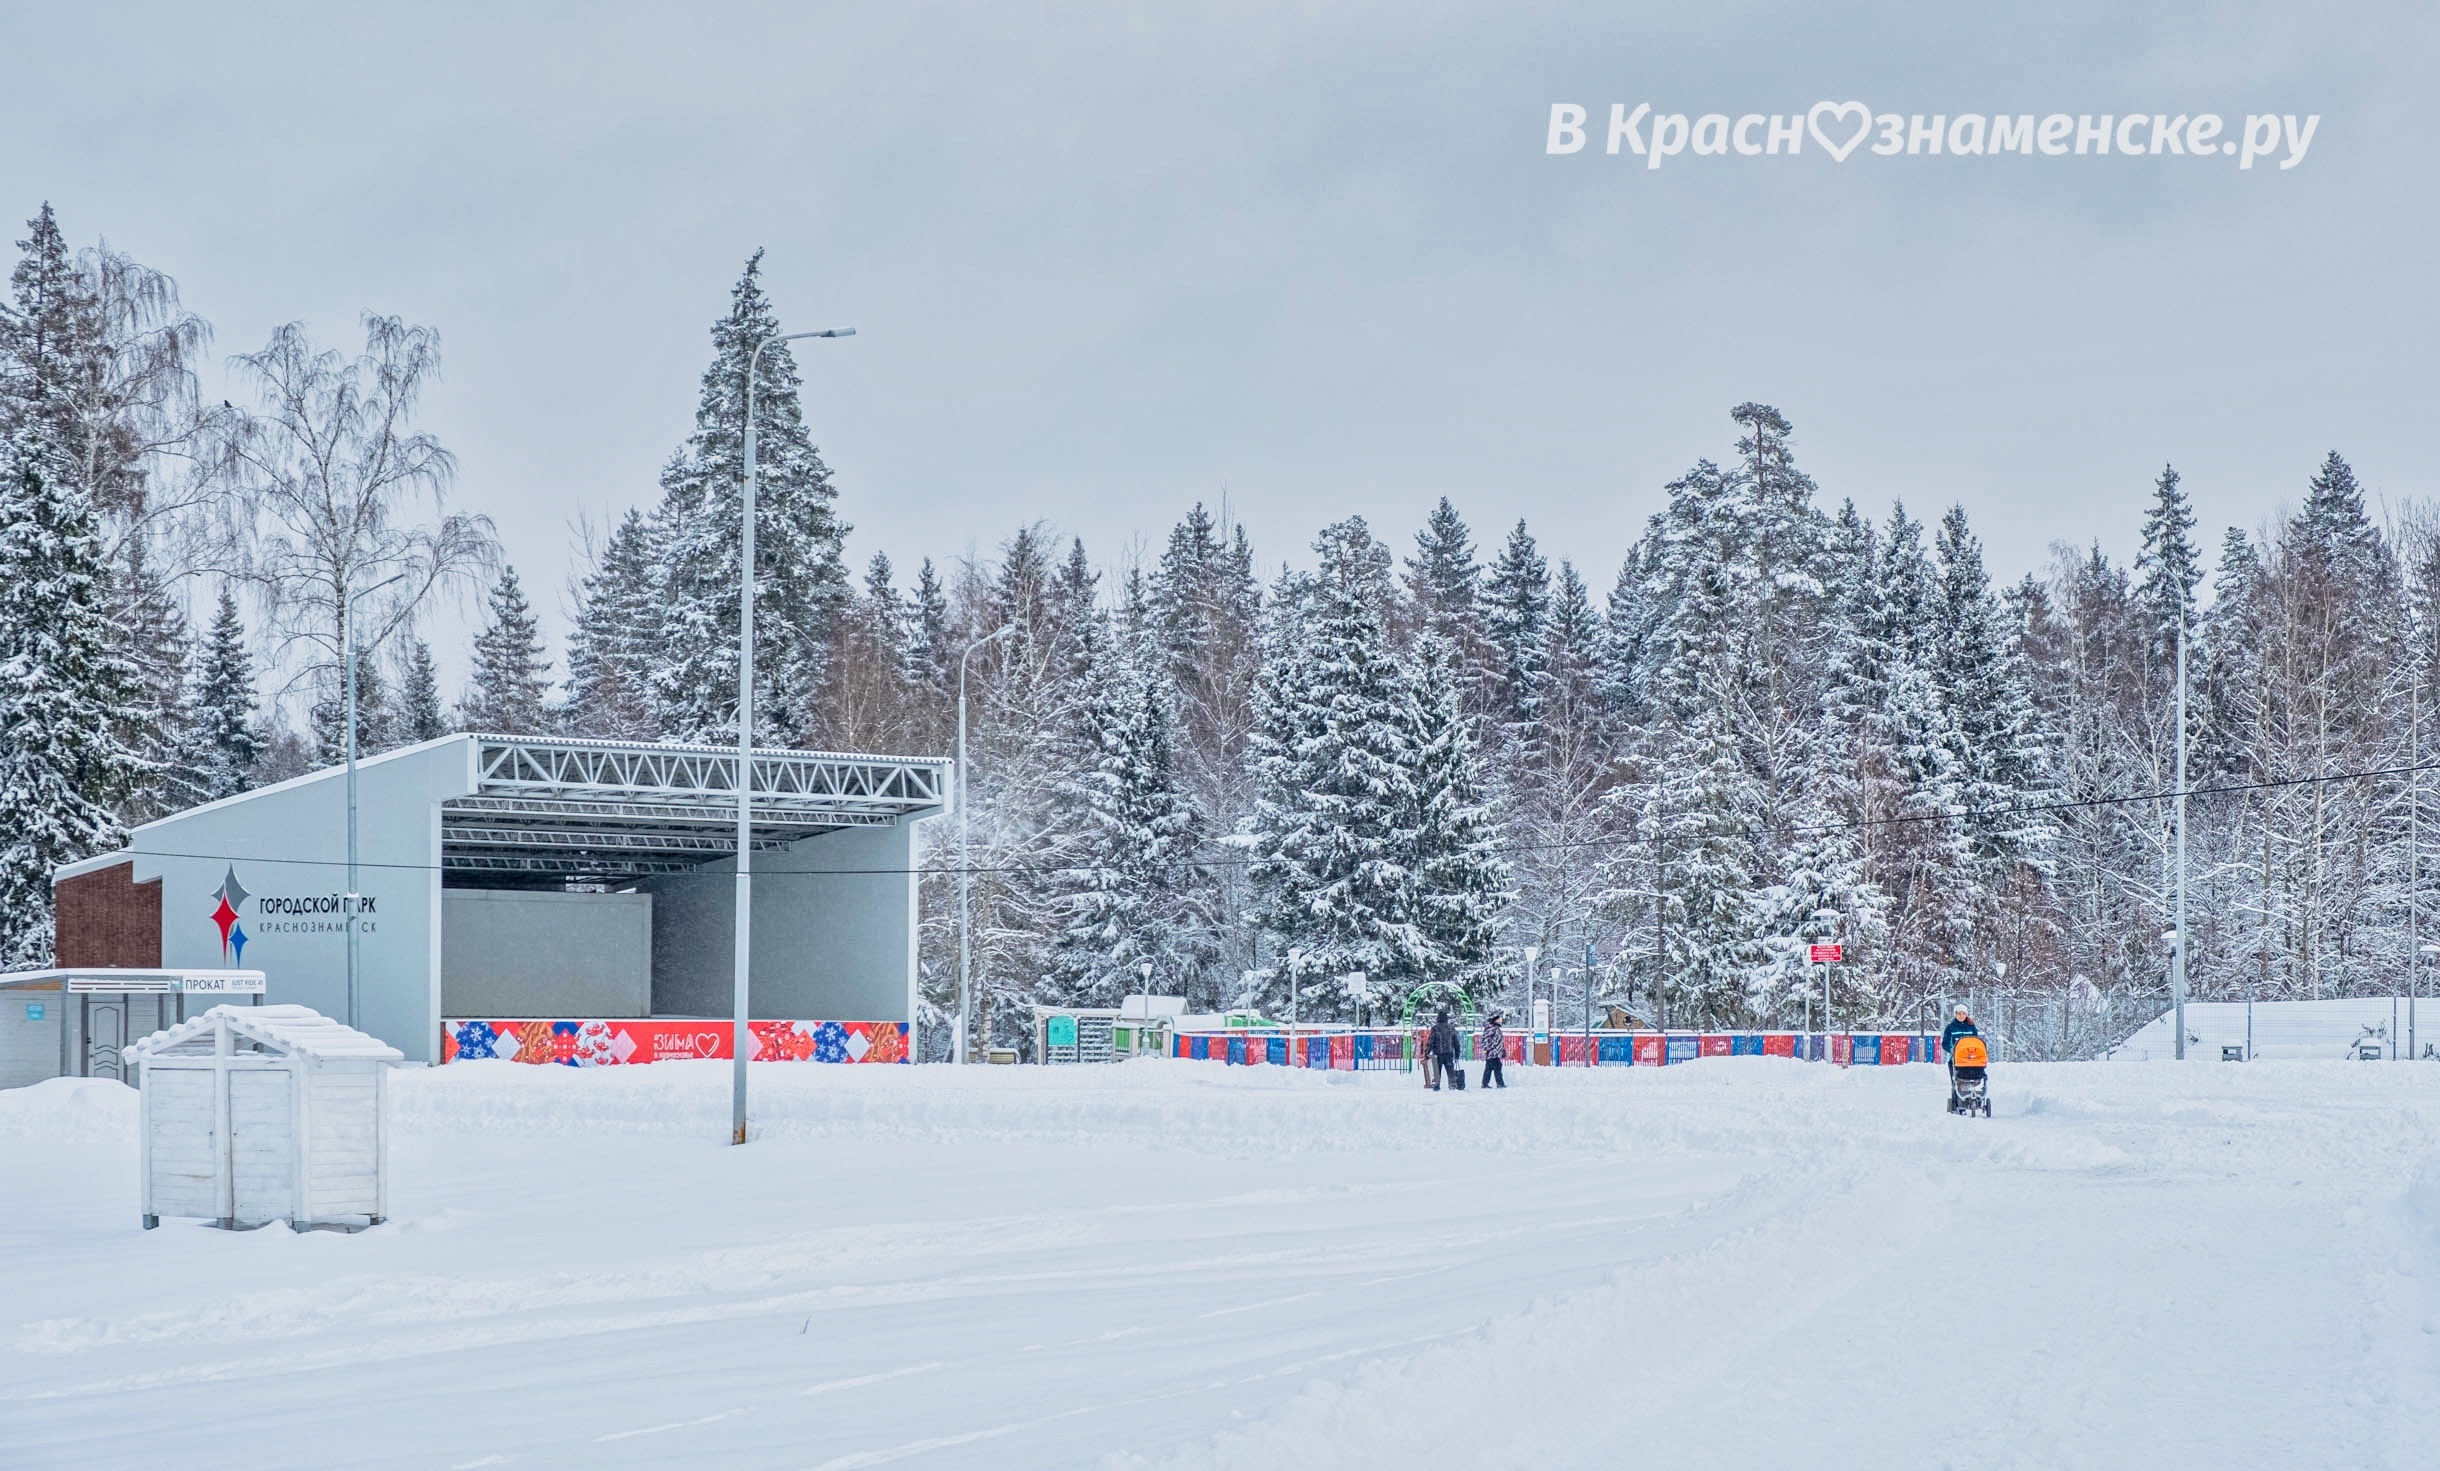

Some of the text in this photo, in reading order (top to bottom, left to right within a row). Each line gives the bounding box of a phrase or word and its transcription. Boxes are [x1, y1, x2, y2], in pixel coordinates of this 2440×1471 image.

[260, 893, 376, 915] ГОРОДСКОЙ ПРК
[260, 921, 377, 933] КРАСНОЗНАМЕСК
[185, 979, 225, 990] ПРОКАТ
